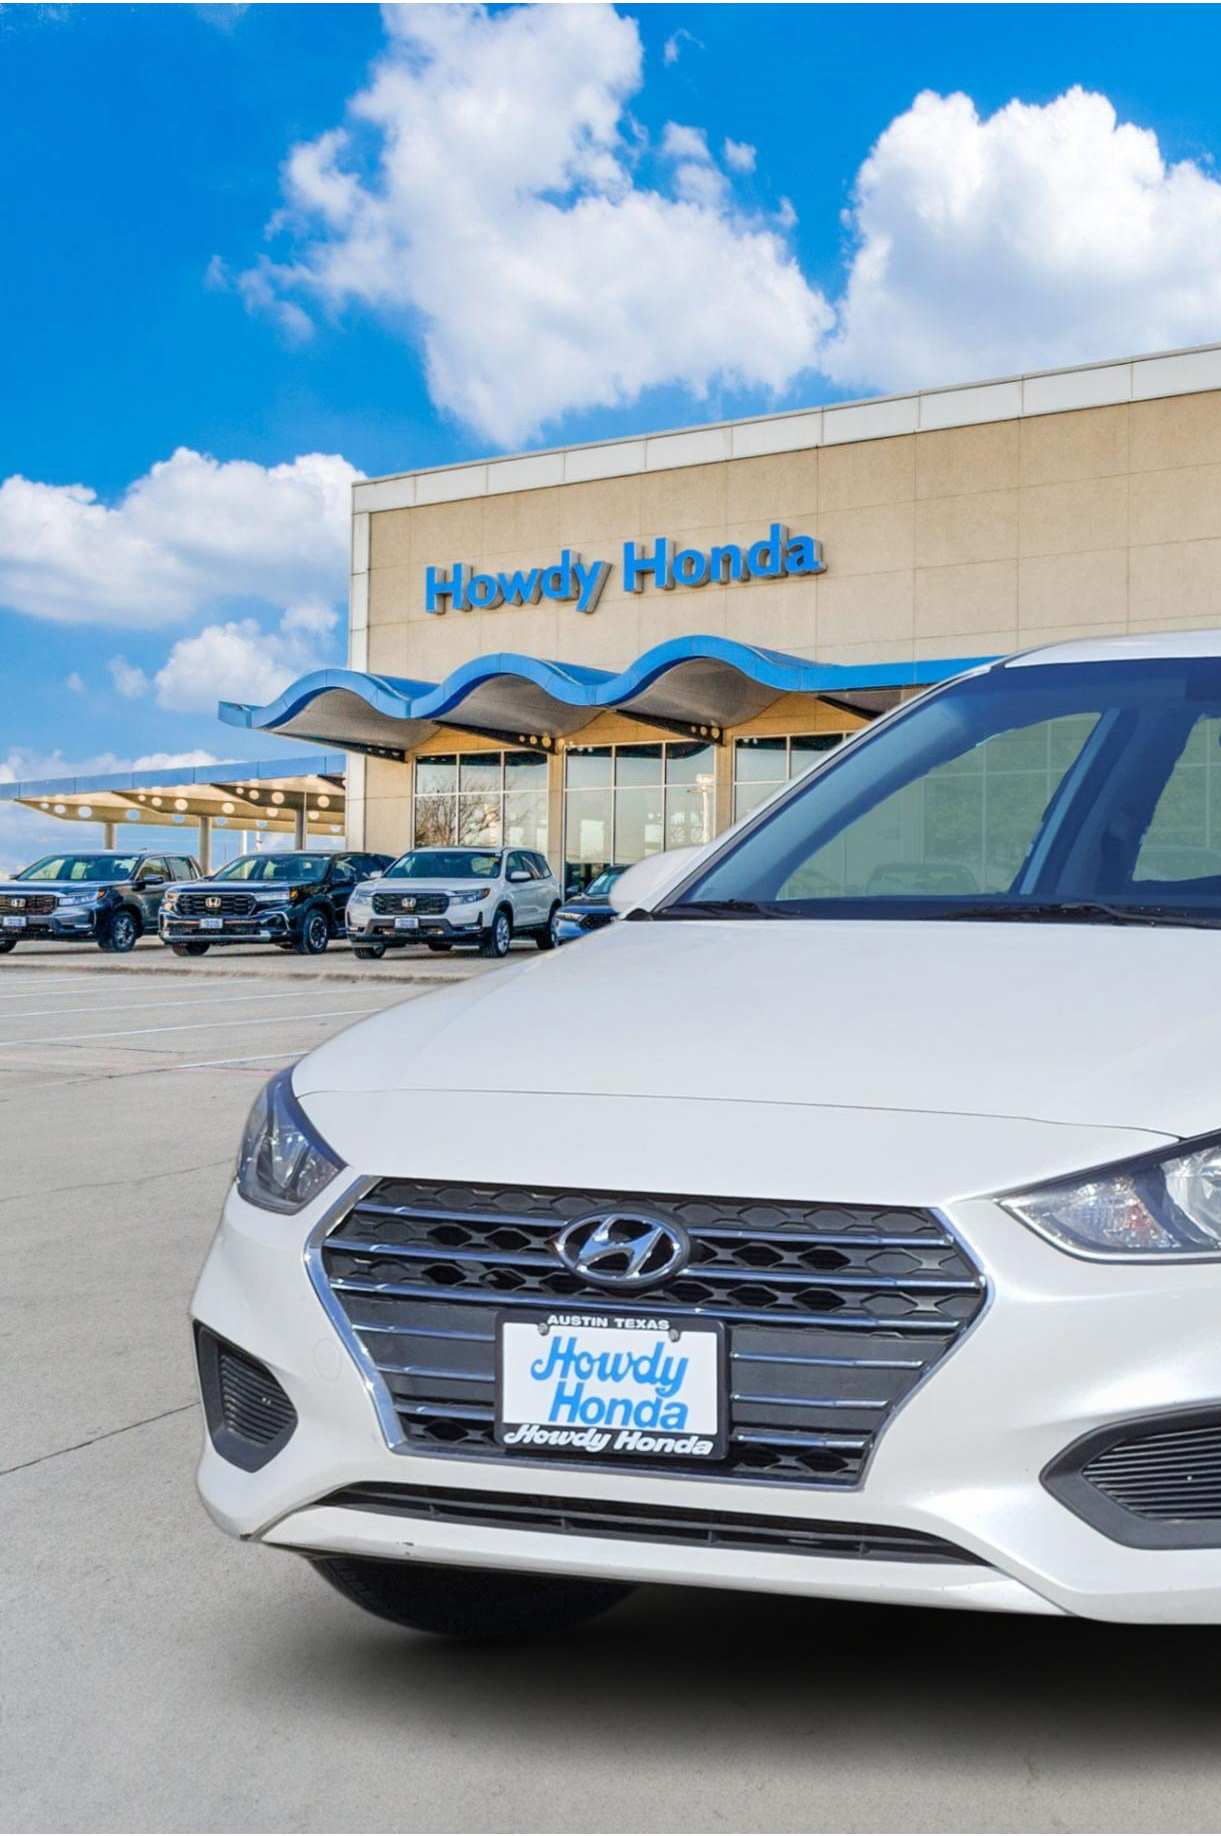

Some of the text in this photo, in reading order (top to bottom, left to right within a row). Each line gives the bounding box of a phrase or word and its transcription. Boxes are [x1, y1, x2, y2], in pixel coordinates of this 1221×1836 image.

[425, 523, 827, 615] Howdy Honda
[546, 1314, 671, 1331] AUSTIN TEXAS
[530, 1335, 689, 1398] Howdy
[548, 1381, 689, 1430] Honda
[503, 1424, 714, 1456] Howdy Honda
